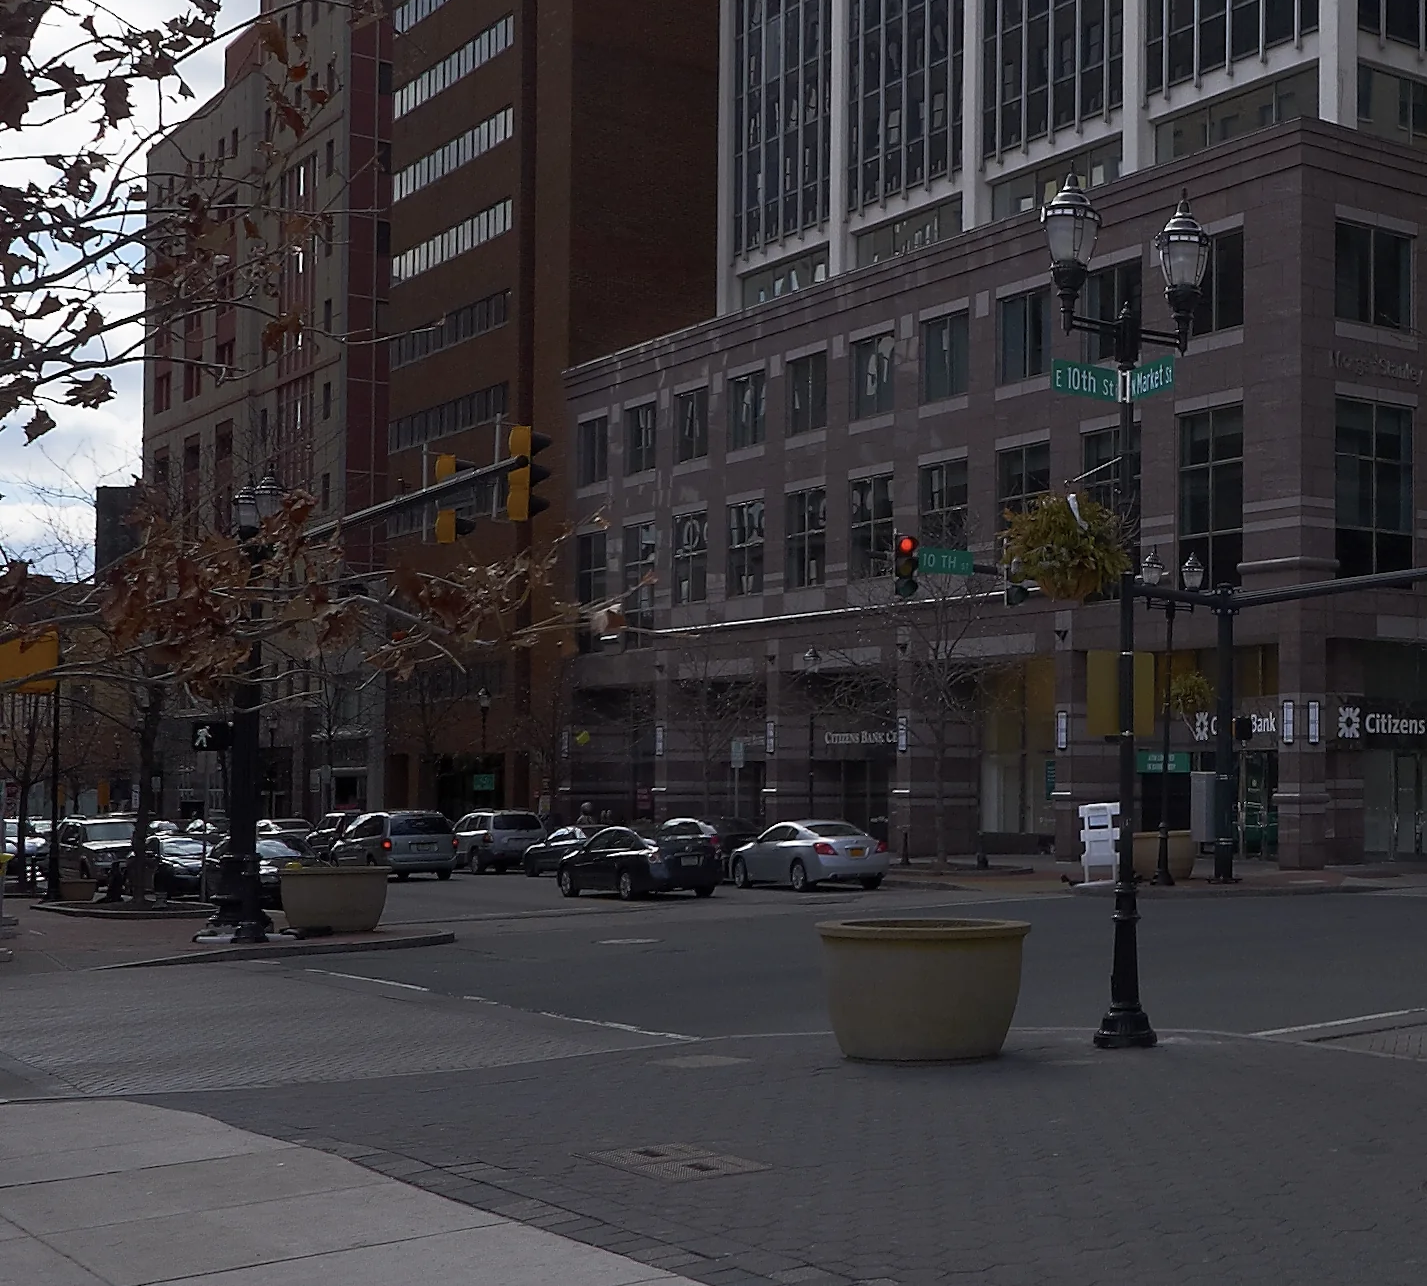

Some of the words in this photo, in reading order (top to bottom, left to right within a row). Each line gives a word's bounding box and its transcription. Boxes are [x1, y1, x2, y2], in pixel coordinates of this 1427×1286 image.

[1056, 369, 1062, 388] E
[1067, 366, 1096, 393] 10th
[1102, 378, 1114, 397] St
[1136, 364, 1163, 395] Market
[1165, 366, 1173, 384] St
[923, 553, 936, 568] 10
[941, 555, 957, 569] TH
[1250, 711, 1277, 733] Bank
[1365, 712, 1426, 735] Citizens
